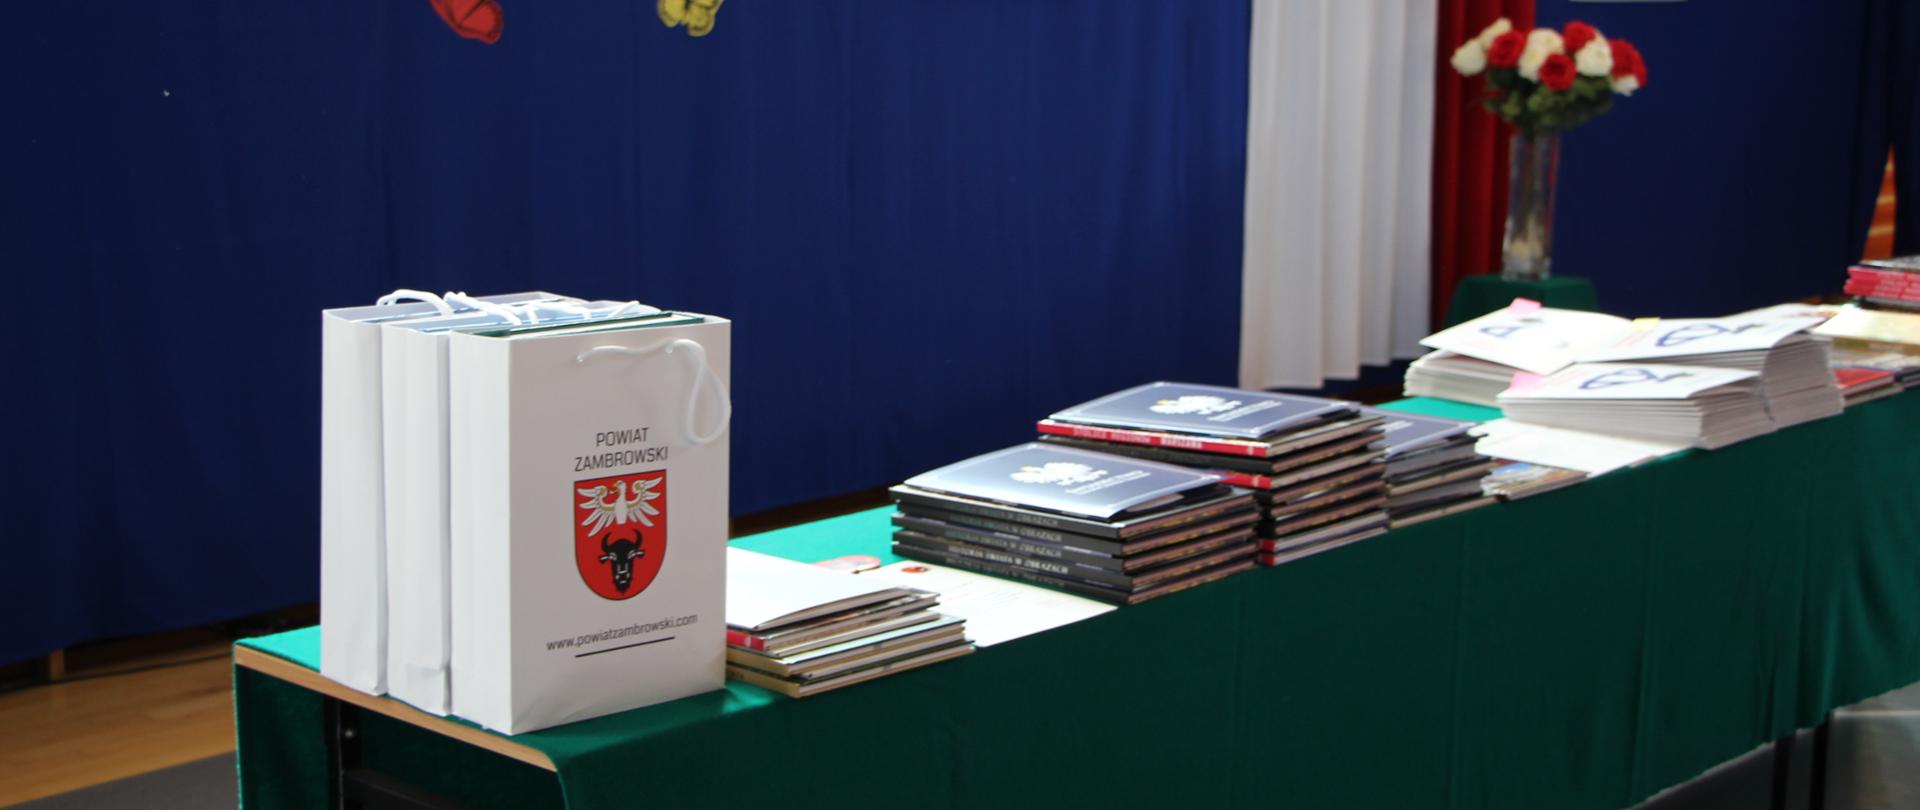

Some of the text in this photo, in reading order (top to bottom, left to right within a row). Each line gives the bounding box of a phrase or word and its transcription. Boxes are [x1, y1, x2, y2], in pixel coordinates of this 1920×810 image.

[596, 427, 649, 447] POWIAT
[574, 446, 669, 472] ZAMBROWSKI
[546, 613, 698, 651] www.powiatzambrowski.com
